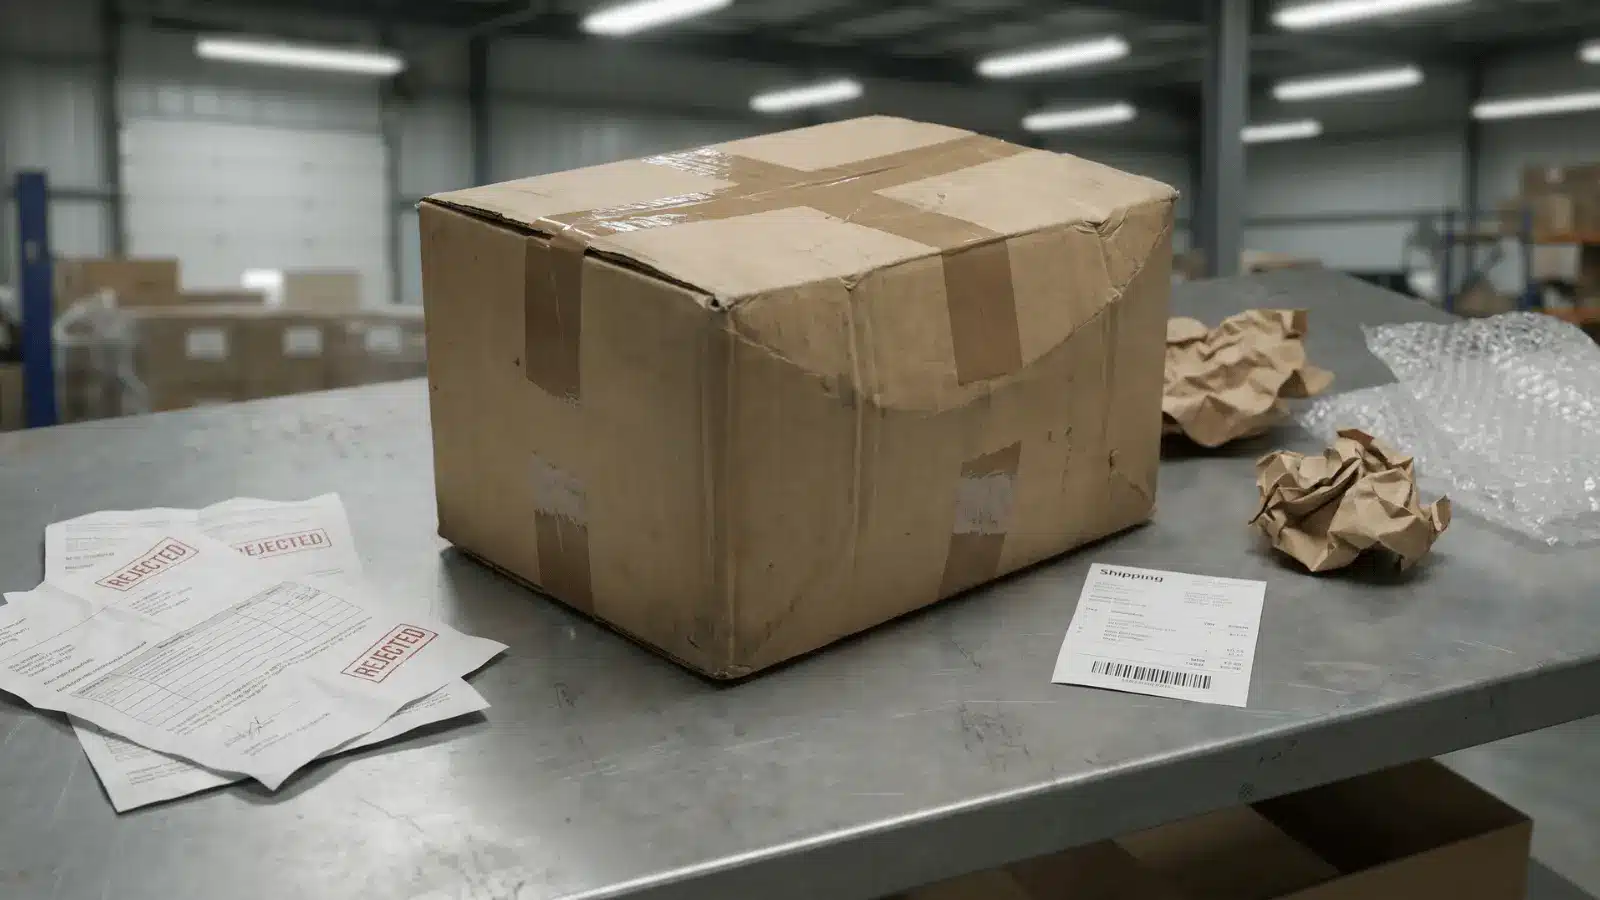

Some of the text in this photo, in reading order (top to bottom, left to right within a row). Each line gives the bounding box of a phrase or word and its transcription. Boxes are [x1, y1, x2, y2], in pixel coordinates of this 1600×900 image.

[238, 532, 323, 556] EJECTED
[107, 544, 186, 587] REJECTED
[1100, 568, 1164, 583] Shipping
[353, 627, 426, 677] REJECTED
